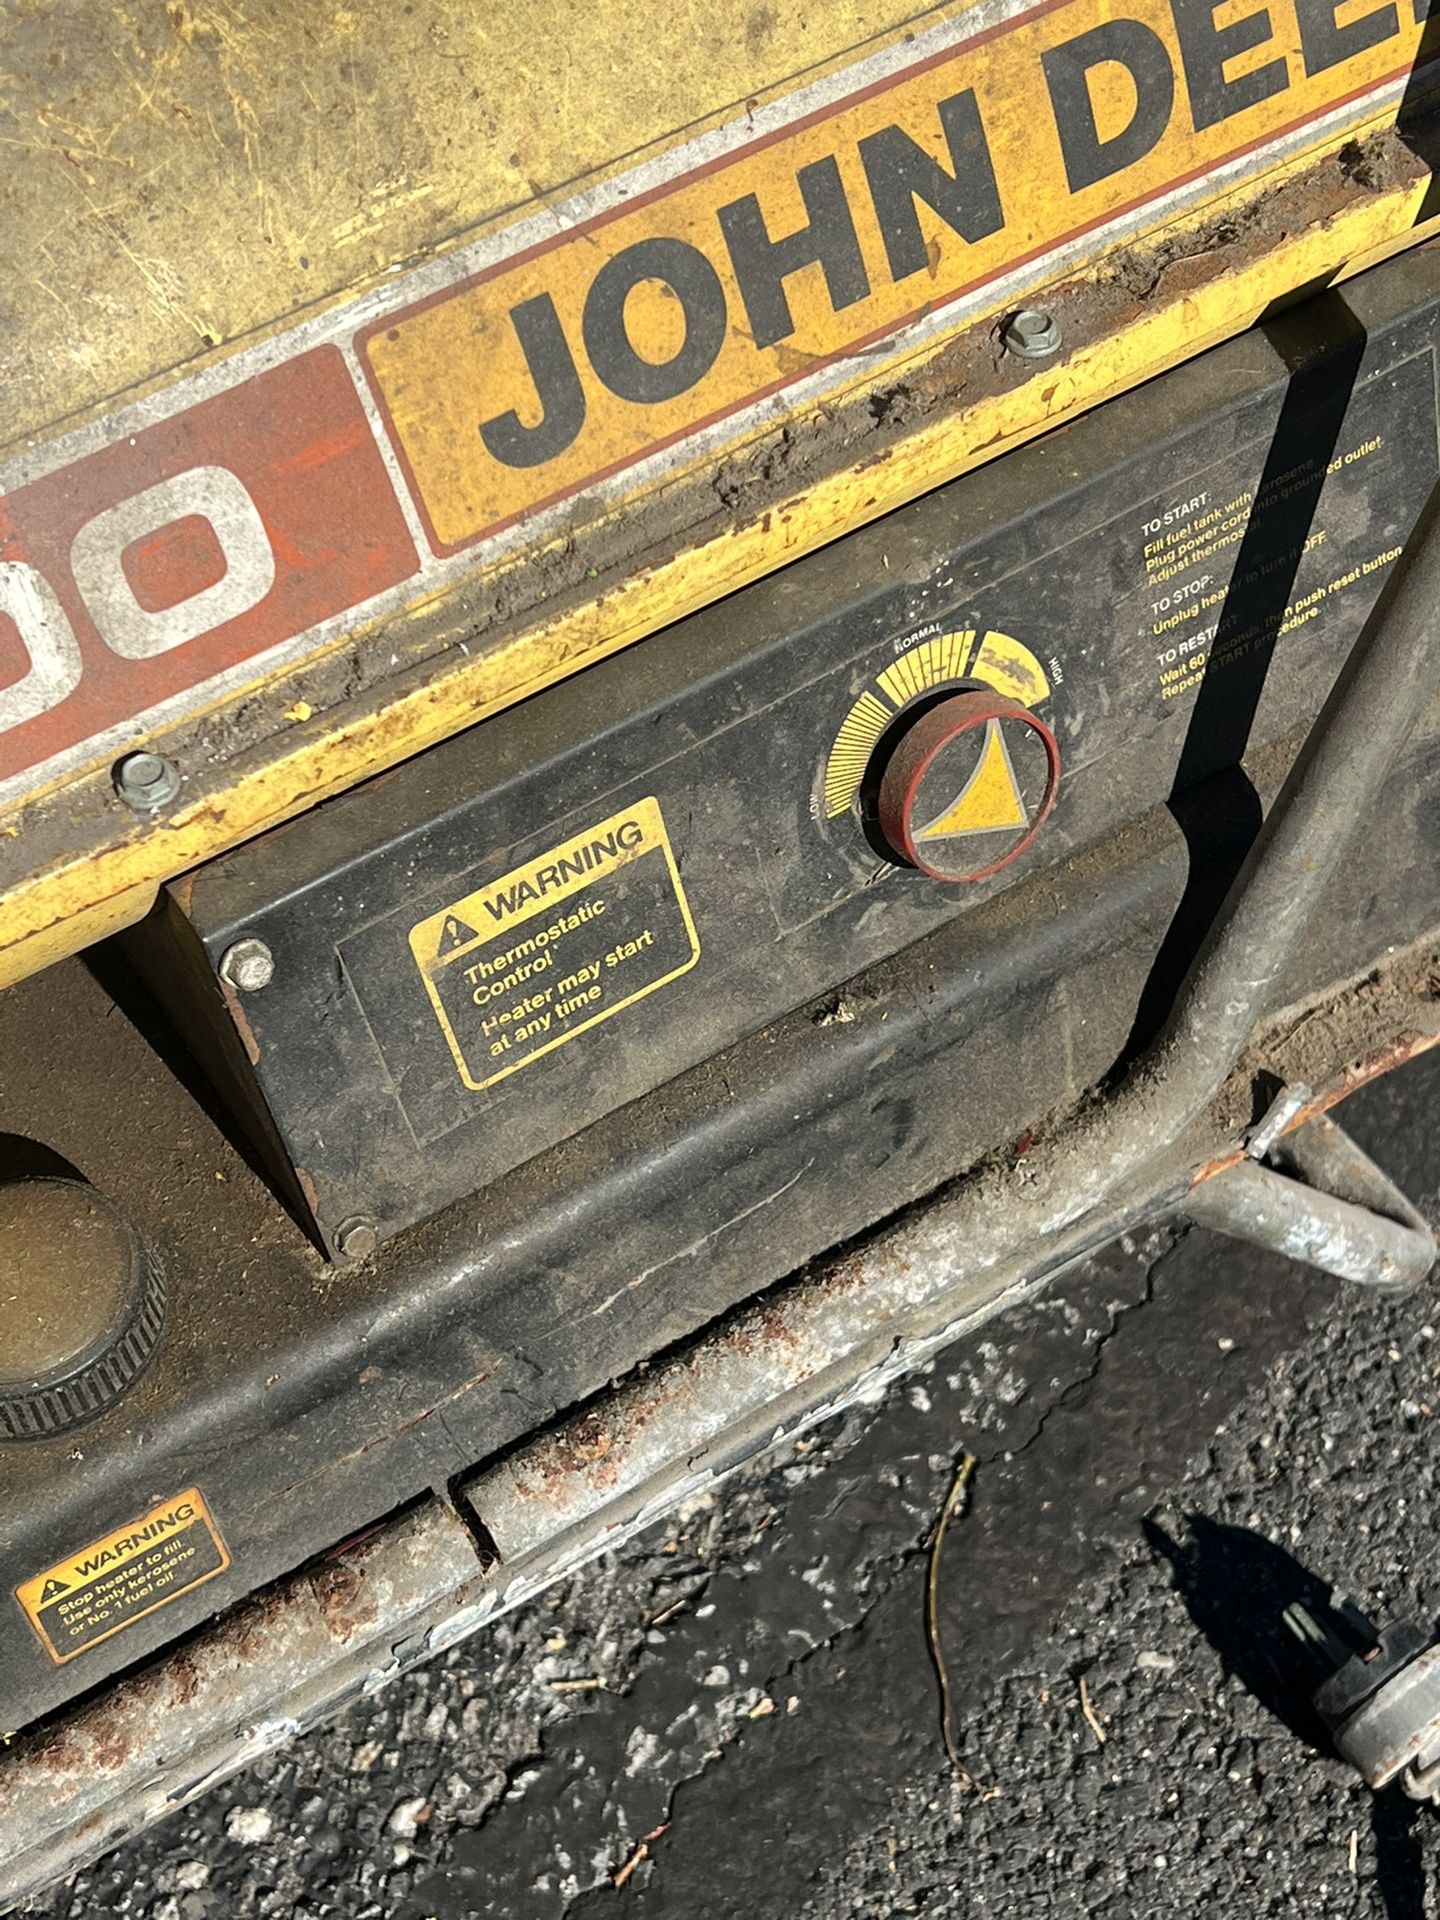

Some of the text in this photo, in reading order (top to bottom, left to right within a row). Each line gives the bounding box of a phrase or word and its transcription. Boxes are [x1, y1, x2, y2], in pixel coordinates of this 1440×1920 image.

[478, 0, 1437, 469] JOHN DEE
[1140, 492, 1212, 537] TO START:
[1143, 458, 1314, 558] Fill fuel tank with erosene
[1145, 551, 1176, 572] Plug
[1178, 527, 1221, 561] power
[1221, 508, 1252, 532] cord
[1281, 457, 1342, 500] grounded
[1147, 560, 1190, 587] Adjust
[1150, 574, 1214, 616] TO STOP:
[1152, 604, 1199, 636] Unplug
[1201, 579, 1242, 610] heater
[1246, 571, 1259, 584] to
[894, 623, 941, 654] NORMAL
[1159, 662, 1188, 687] Wait
[1189, 653, 1206, 672] 60
[1295, 587, 1327, 612] push
[1328, 567, 1361, 594] reset
[1362, 546, 1402, 575] button
[1049, 656, 1064, 686] HIGH
[1156, 648, 1176, 667] TO
[1161, 668, 1207, 701] Repeat
[1208, 641, 1250, 674] START
[809, 793, 820, 821] LOW
[483, 821, 643, 921] WARNING
[463, 899, 606, 985] Thermostatic
[472, 950, 553, 1005] Control
[481, 929, 653, 1037] Heater may start
[489, 985, 602, 1057] at any time
[74, 1503, 195, 1577] WARNING
[57, 1591, 94, 1616] Stop
[95, 1563, 144, 1594] heater
[145, 1553, 162, 1566] to
[63, 1547, 196, 1626] Use only kerosene
[69, 1623, 85, 1636] or
[88, 1608, 113, 1626] No.
[125, 1585, 153, 1605] fuel
